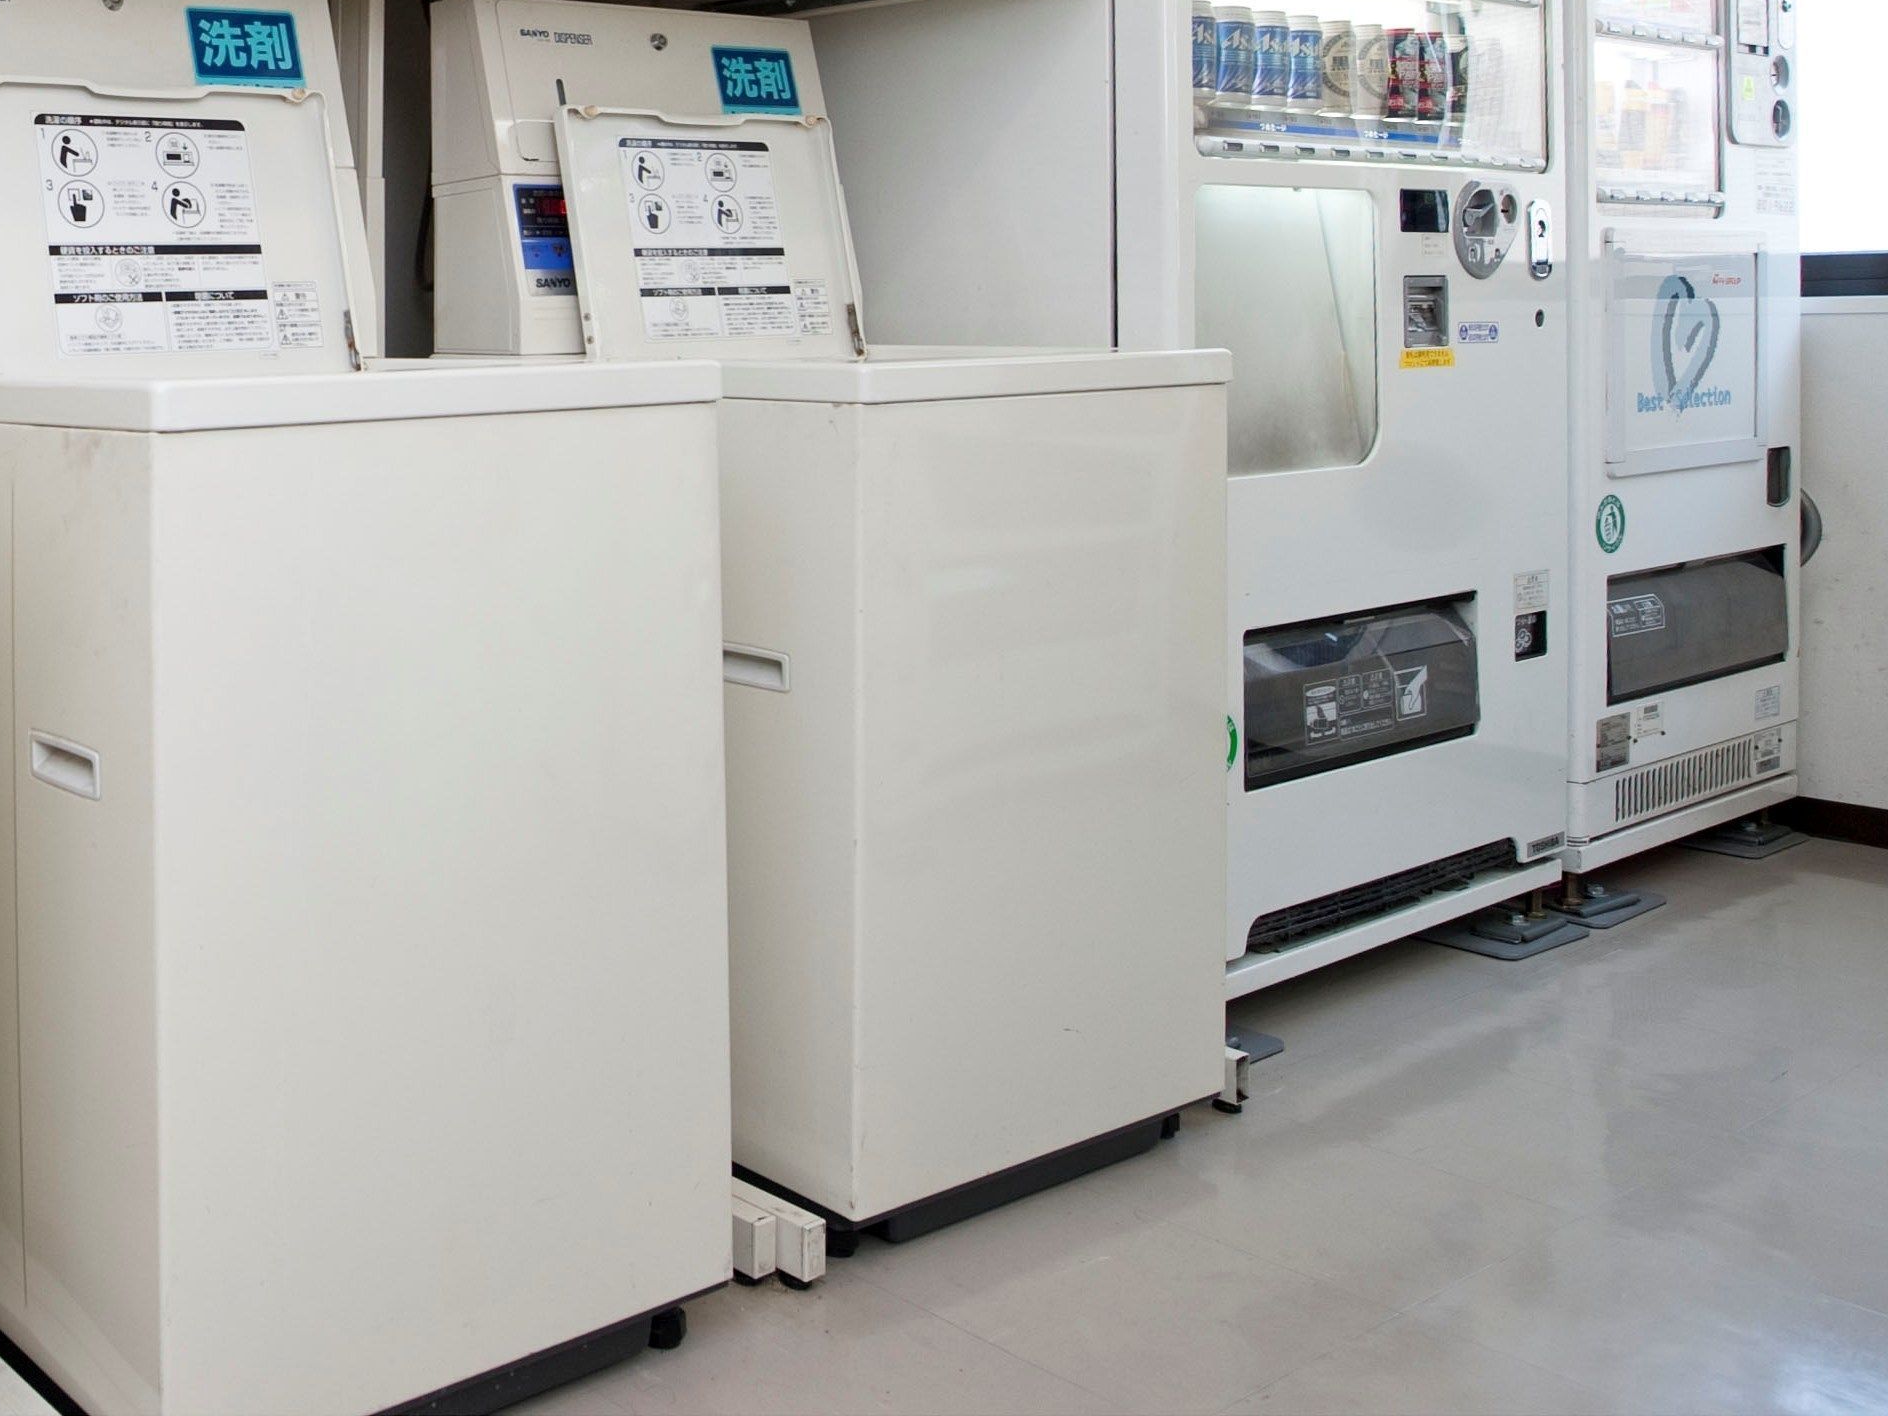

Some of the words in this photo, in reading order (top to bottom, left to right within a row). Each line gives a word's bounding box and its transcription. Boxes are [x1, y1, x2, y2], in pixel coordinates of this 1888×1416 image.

[198, 18, 293, 71] 洗剤
[519, 28, 550, 39] SANYO
[553, 32, 594, 46] DISPENSER
[721, 55, 791, 100] 洗剤
[144, 131, 152, 143] 2
[535, 278, 571, 288] SANYO
[1637, 392, 1663, 413] Best
[1675, 386, 1731, 411] Selection
